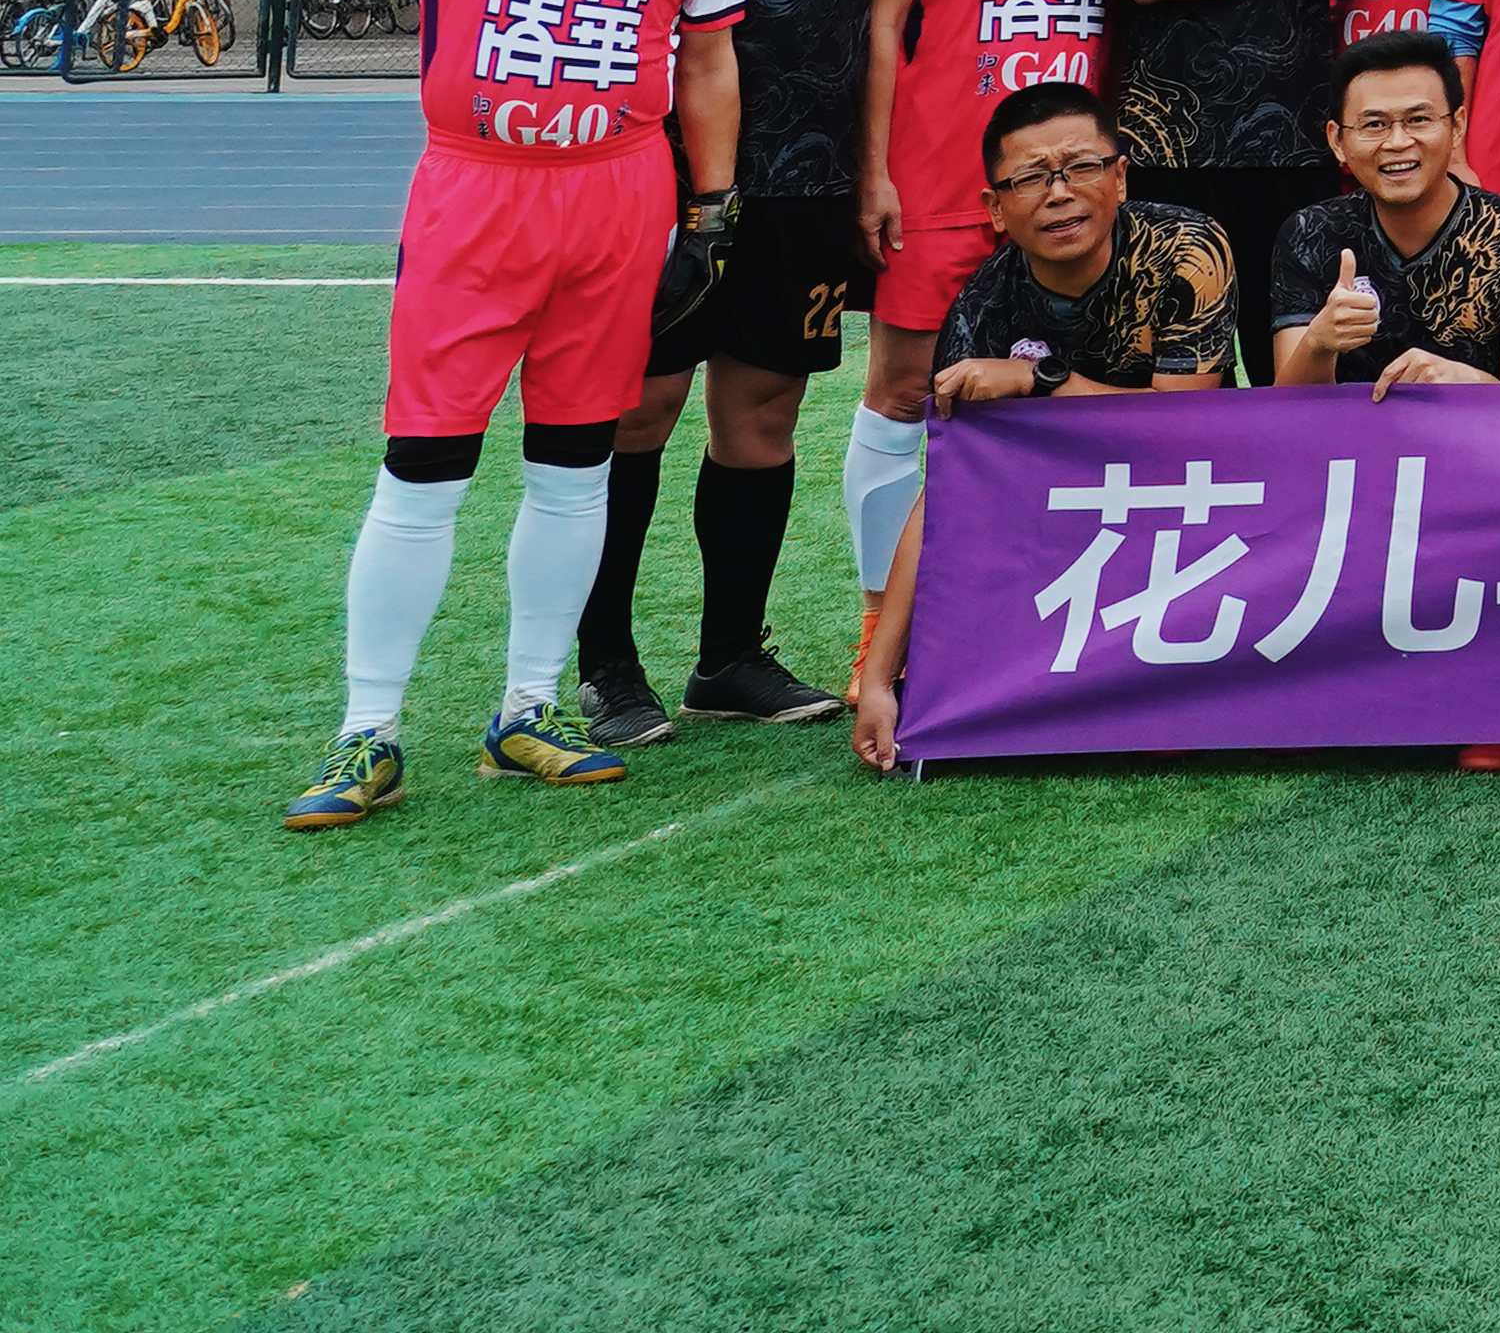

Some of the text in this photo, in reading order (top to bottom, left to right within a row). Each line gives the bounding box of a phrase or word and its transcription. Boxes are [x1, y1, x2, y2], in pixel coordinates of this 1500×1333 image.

[1001, 51, 1089, 92] G40
[494, 99, 609, 148] G40
[804, 280, 847, 340] 22
